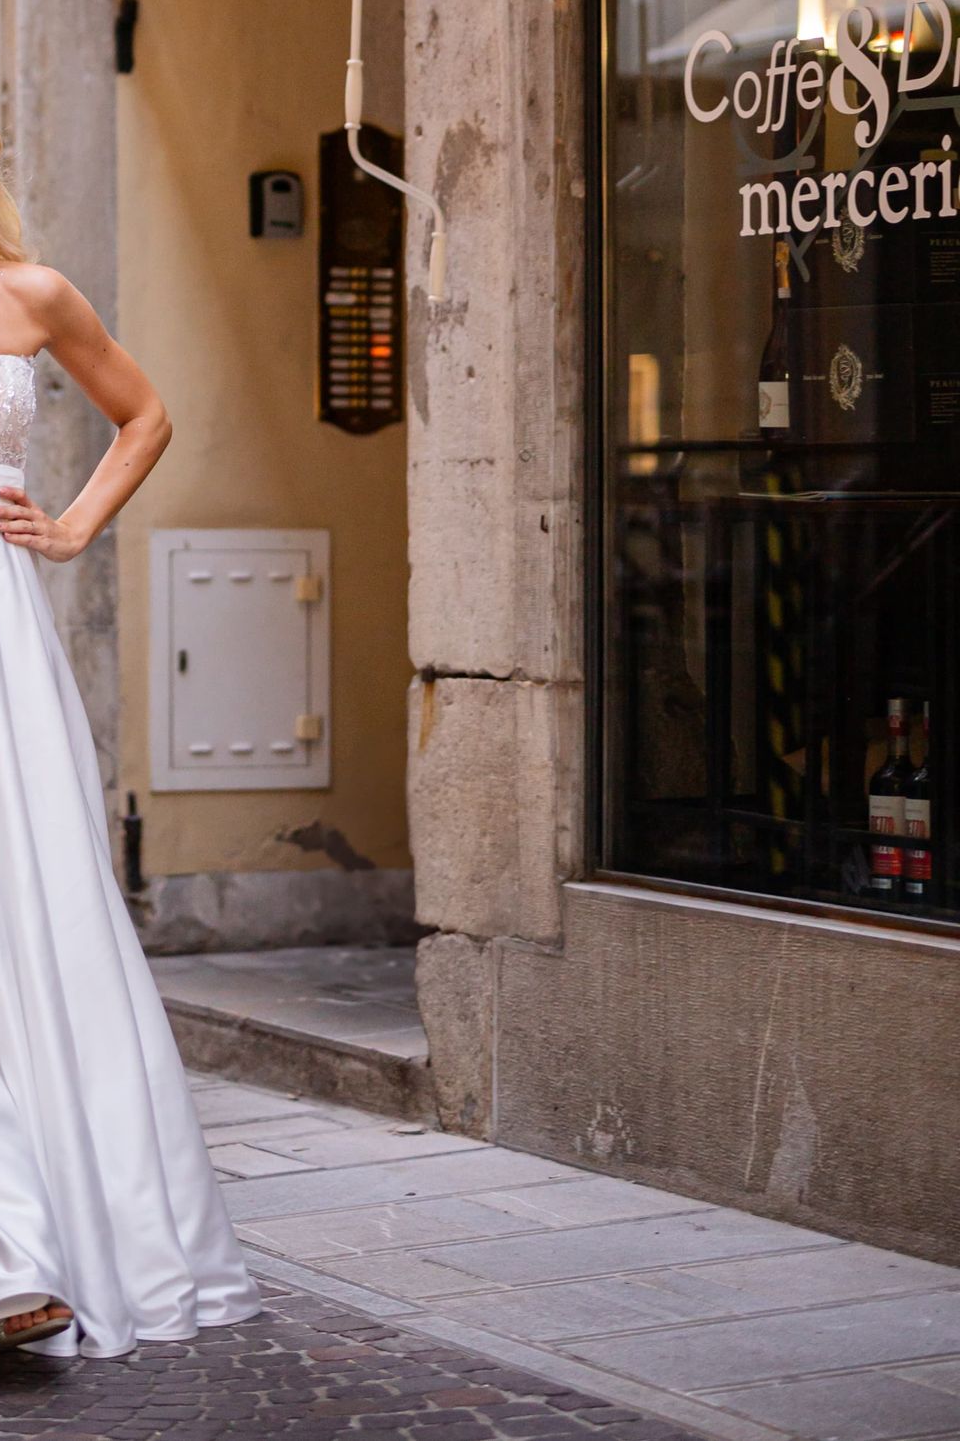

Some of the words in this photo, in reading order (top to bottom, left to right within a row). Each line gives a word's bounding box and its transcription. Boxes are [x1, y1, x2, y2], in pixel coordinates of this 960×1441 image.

[684, 30, 824, 134] Coffe
[829, 6, 890, 148] &
[739, 134, 960, 236] merceri
